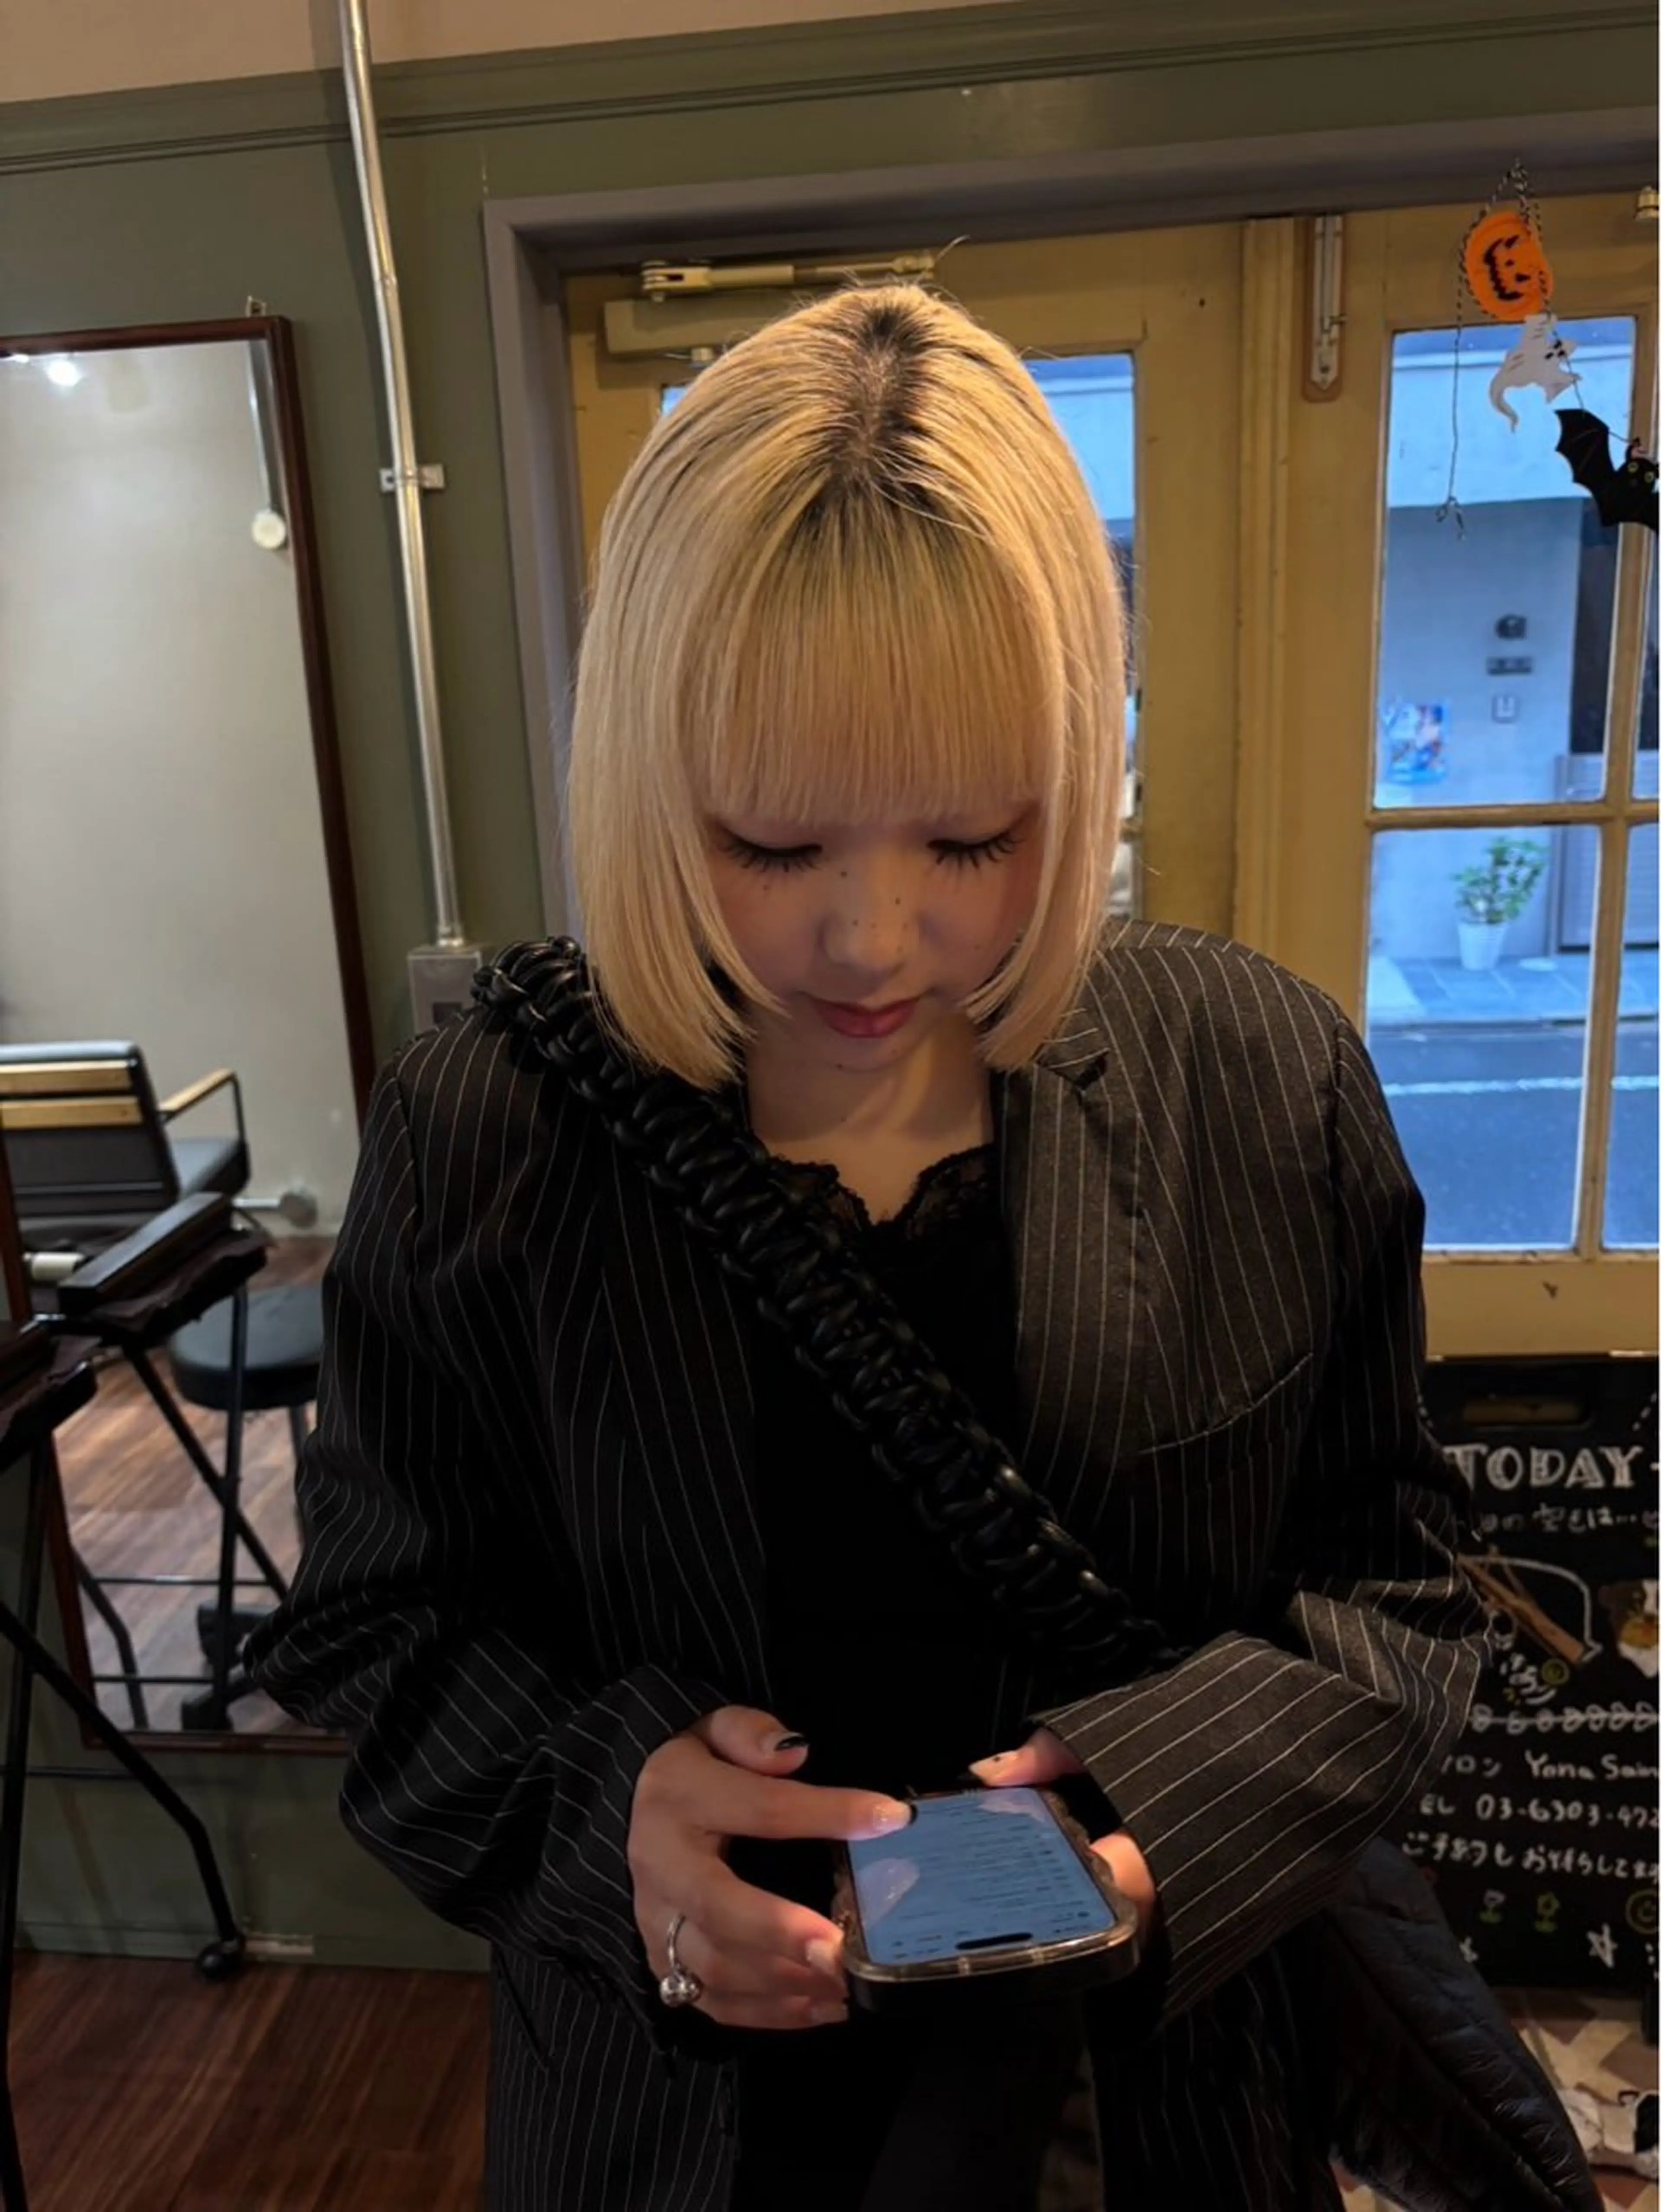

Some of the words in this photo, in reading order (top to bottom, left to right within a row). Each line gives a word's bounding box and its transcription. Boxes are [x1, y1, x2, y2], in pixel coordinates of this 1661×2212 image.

[1441, 1442, 1644, 1491] TODAY
[1440, 1754, 1503, 1779] ロン
[1419, 1792, 1456, 1817] EL
